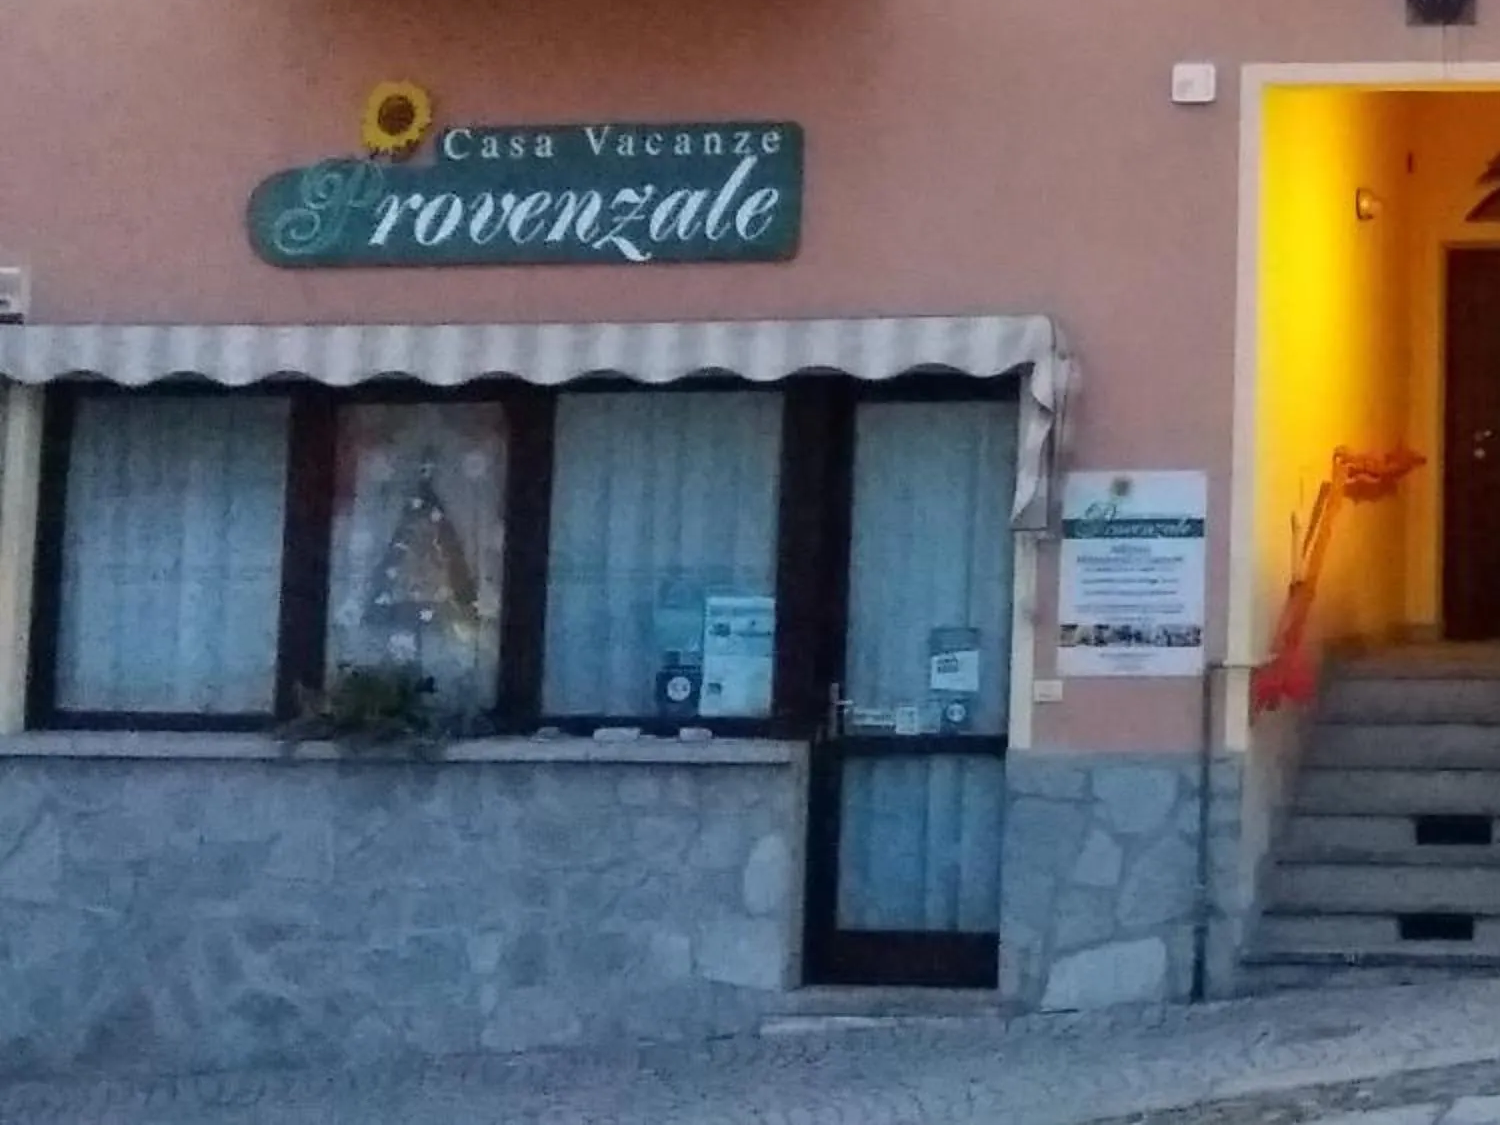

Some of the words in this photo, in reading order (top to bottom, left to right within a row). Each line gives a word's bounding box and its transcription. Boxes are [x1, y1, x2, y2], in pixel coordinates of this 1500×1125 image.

[443, 128, 555, 160] Casa
[583, 126, 782, 156] Vacanze
[272, 155, 780, 261] Provenzale
